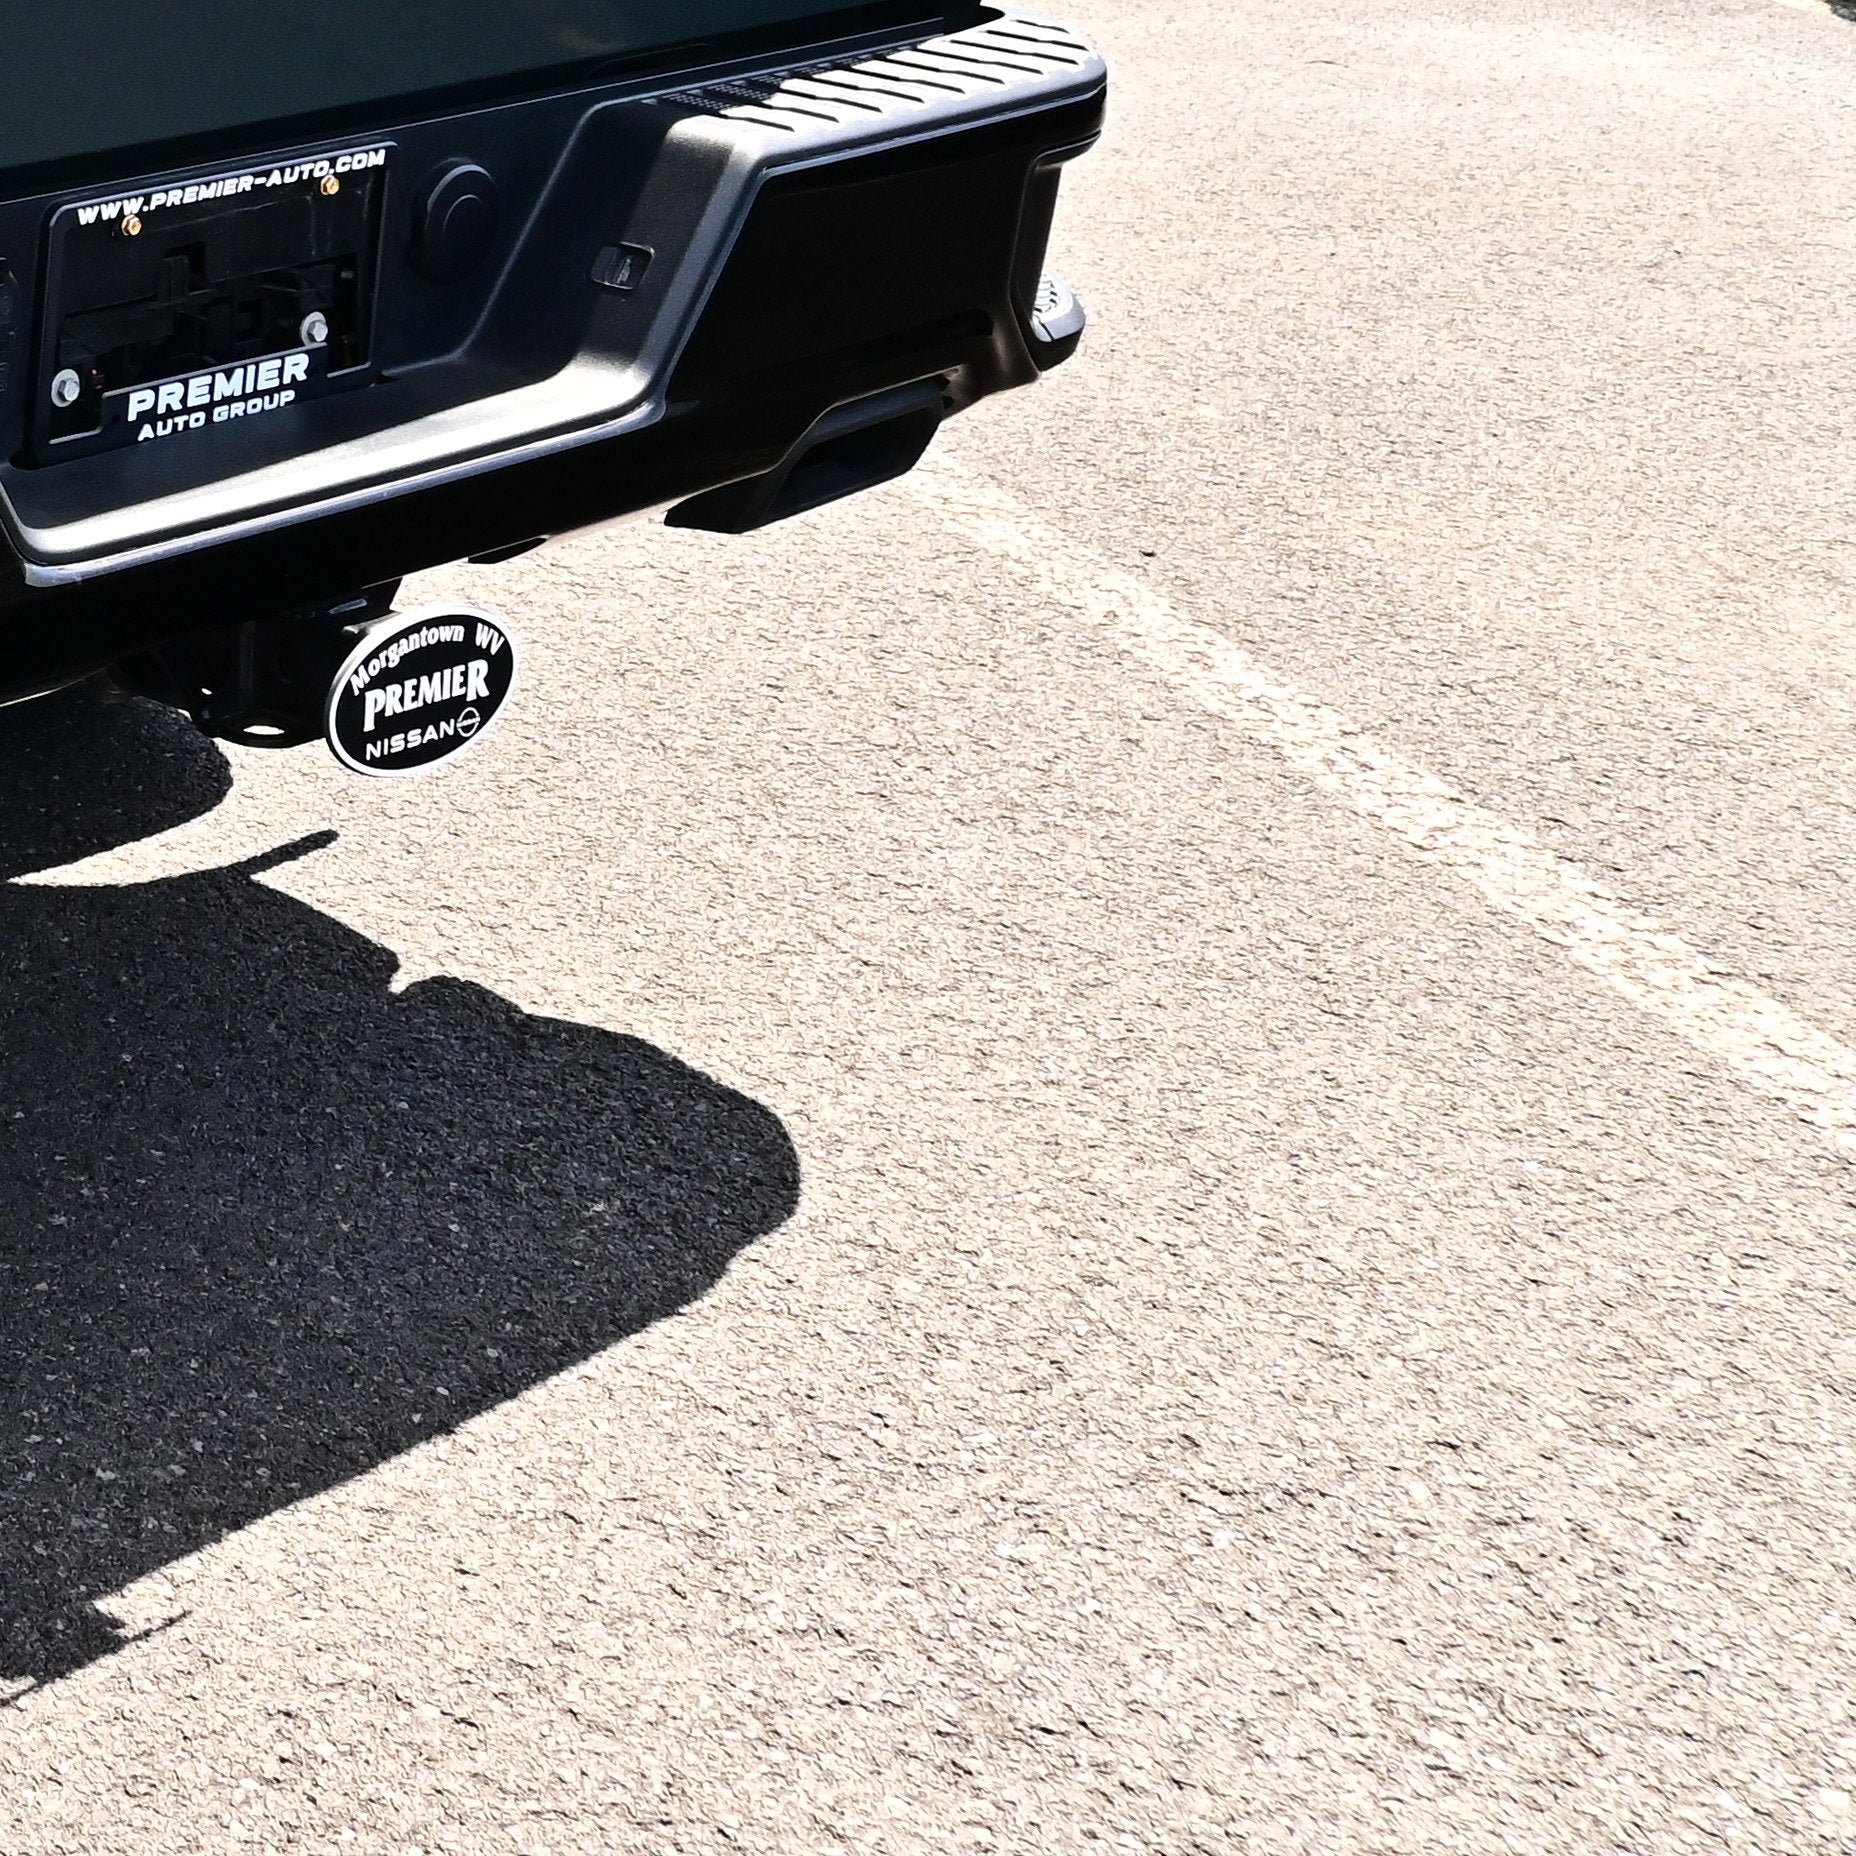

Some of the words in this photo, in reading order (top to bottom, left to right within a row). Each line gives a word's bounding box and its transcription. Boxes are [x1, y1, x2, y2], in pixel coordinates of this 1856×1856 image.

[77, 148, 386, 226] WWW.PREMIER-AUTO.COM
[126, 352, 311, 422] PREMIER
[137, 411, 206, 441] AUTO
[212, 389, 296, 423] GROUP
[349, 624, 465, 697] Morgantown
[474, 622, 506, 657] WV
[363, 659, 491, 733] PREMIER
[366, 718, 455, 761] NISSAN
